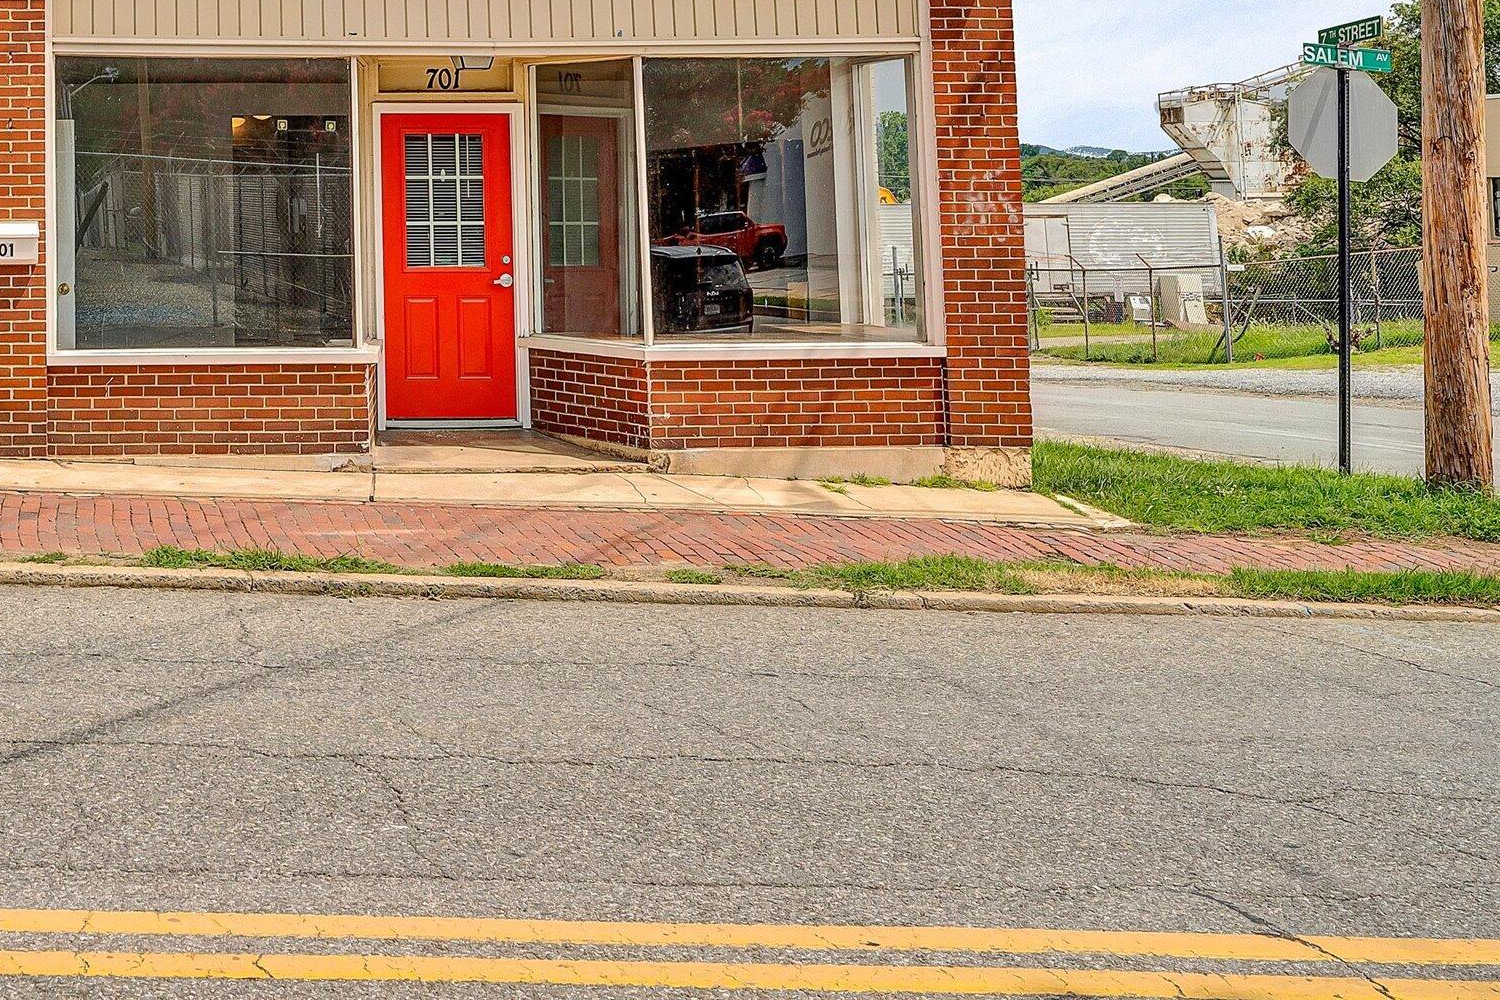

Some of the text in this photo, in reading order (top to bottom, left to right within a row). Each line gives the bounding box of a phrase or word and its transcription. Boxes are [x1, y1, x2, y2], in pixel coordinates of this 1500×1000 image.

[1338, 19, 1380, 44] STREET
[1304, 46, 1389, 66] SALEM AV
[426, 68, 460, 89] 701
